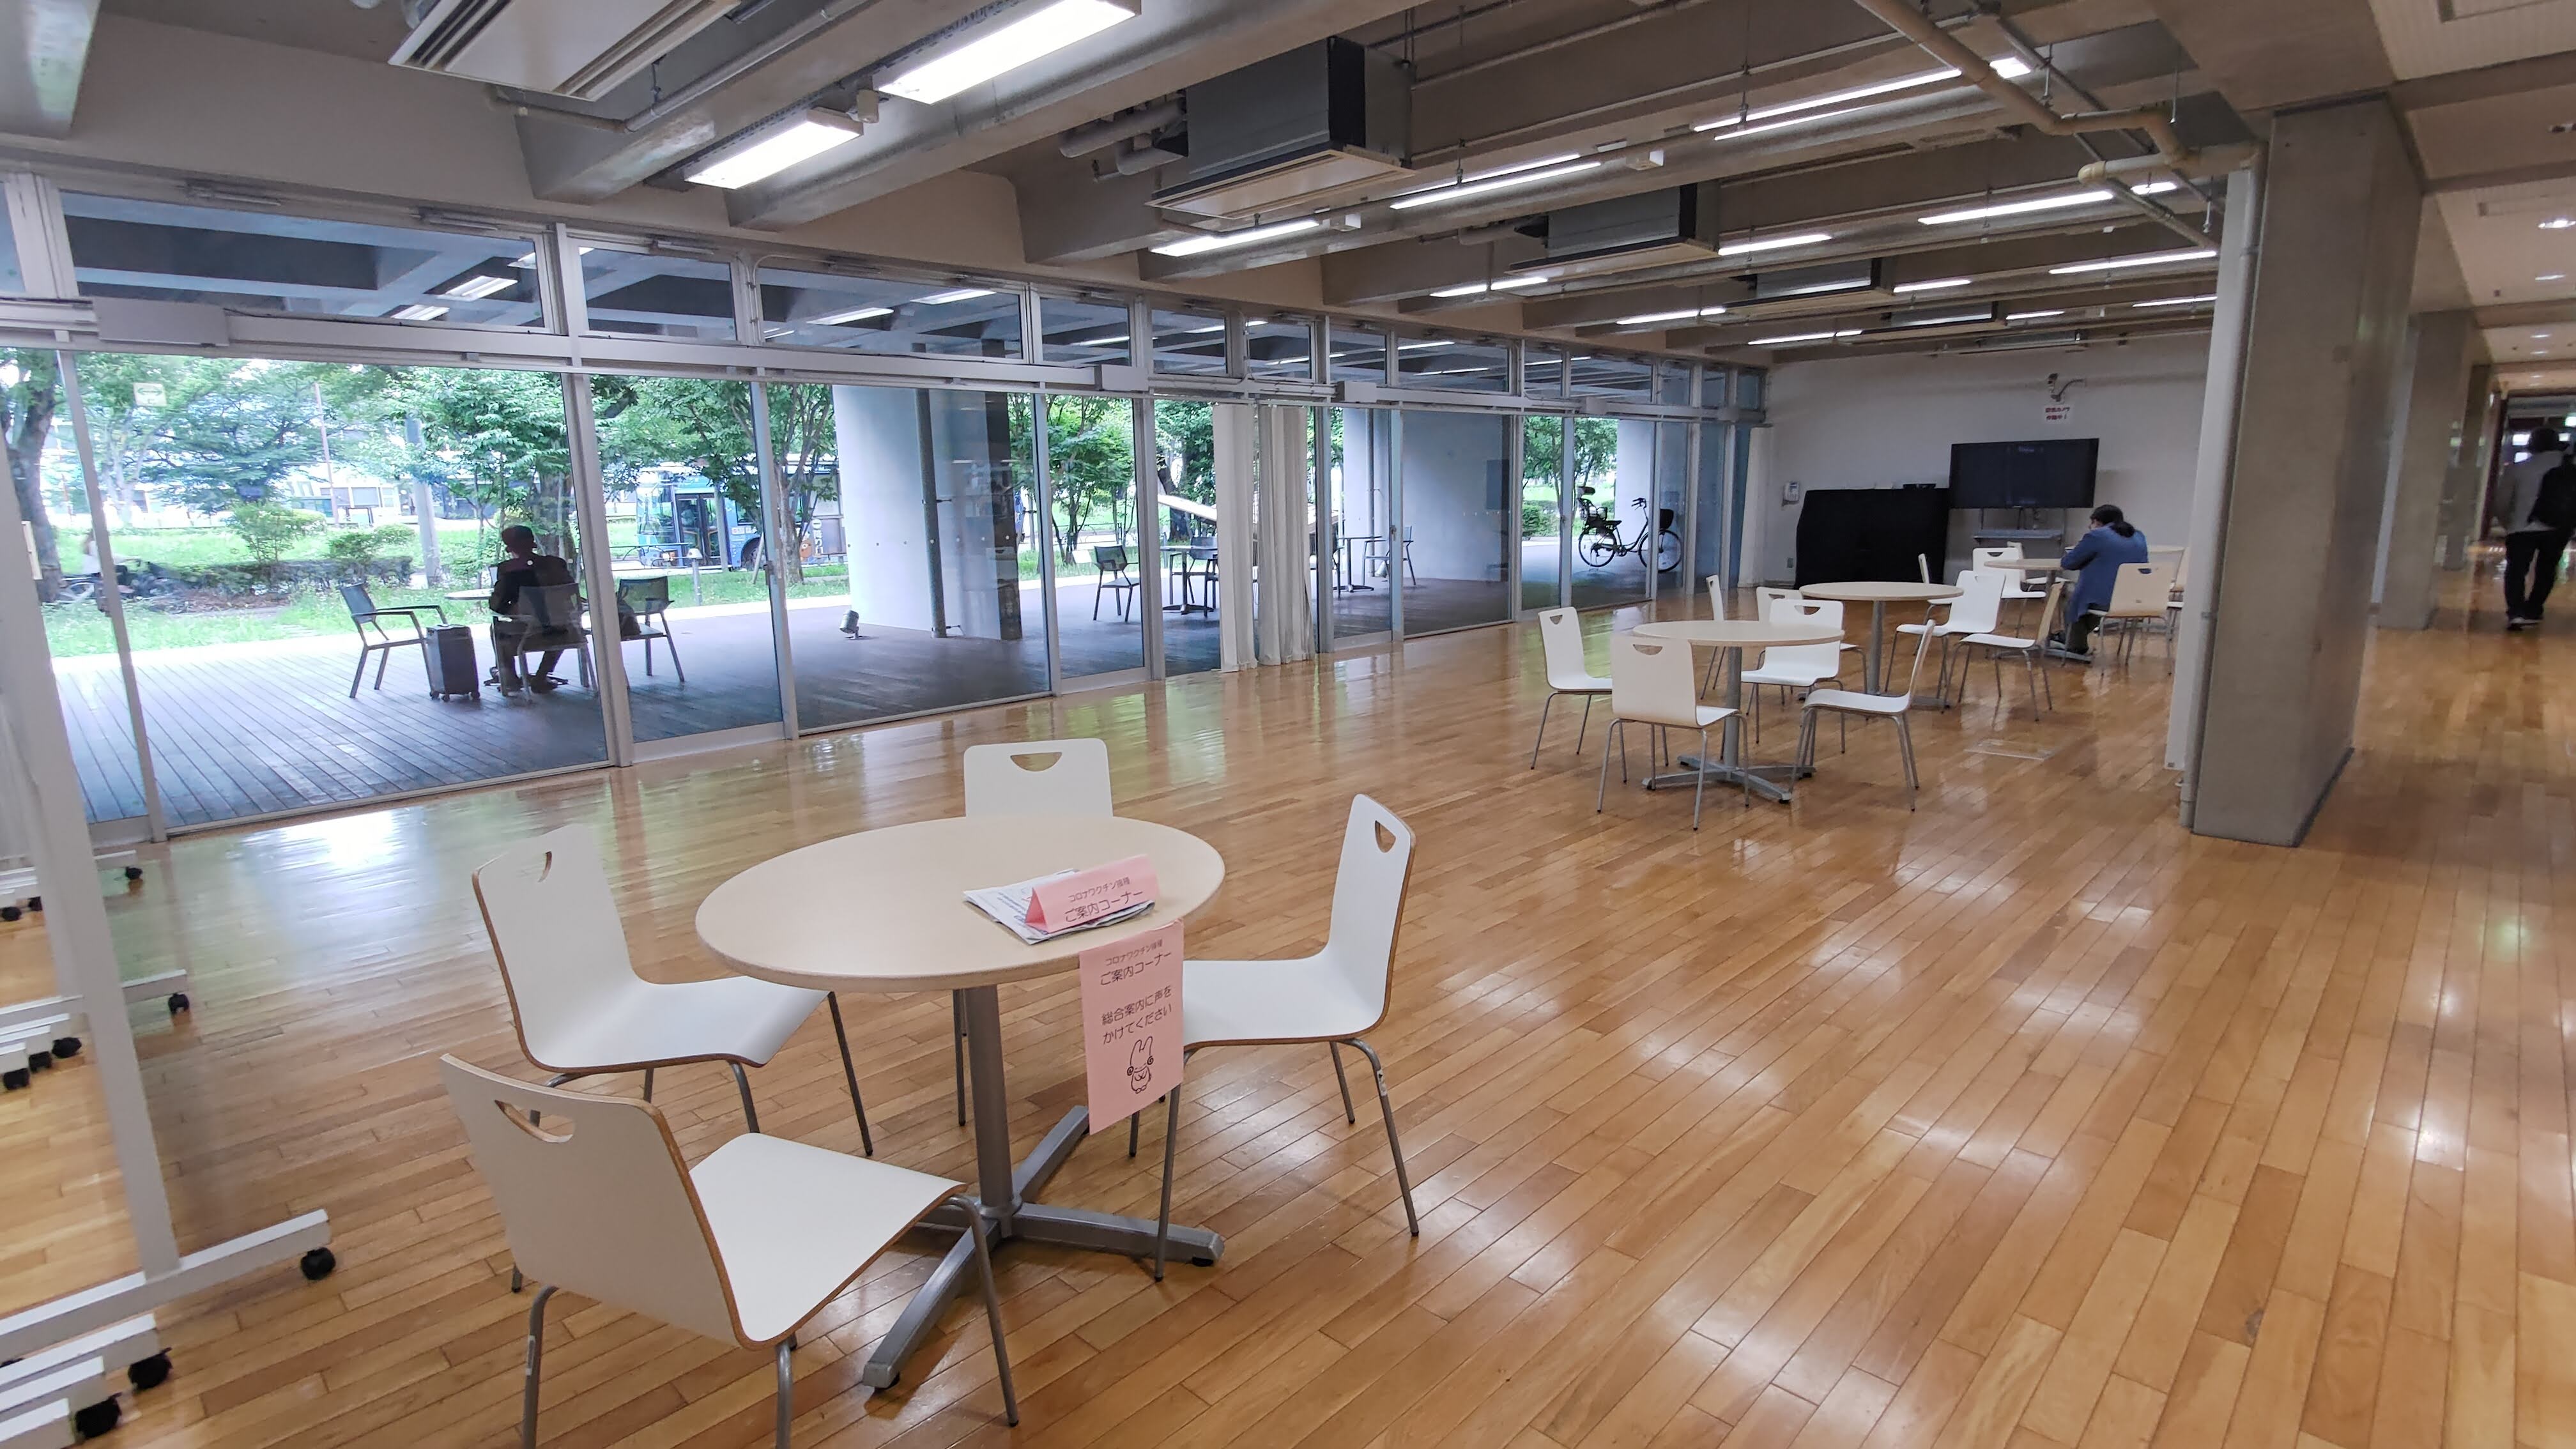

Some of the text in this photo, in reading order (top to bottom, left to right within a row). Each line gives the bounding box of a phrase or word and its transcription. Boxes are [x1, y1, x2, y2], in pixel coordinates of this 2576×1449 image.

[1064, 891, 1143, 923] ご案内コーナー
[1101, 952, 1171, 986] ご案内コーナー
[1101, 985, 1172, 1025] 総合案内に声を
[1103, 1004, 1172, 1045] かけてください
